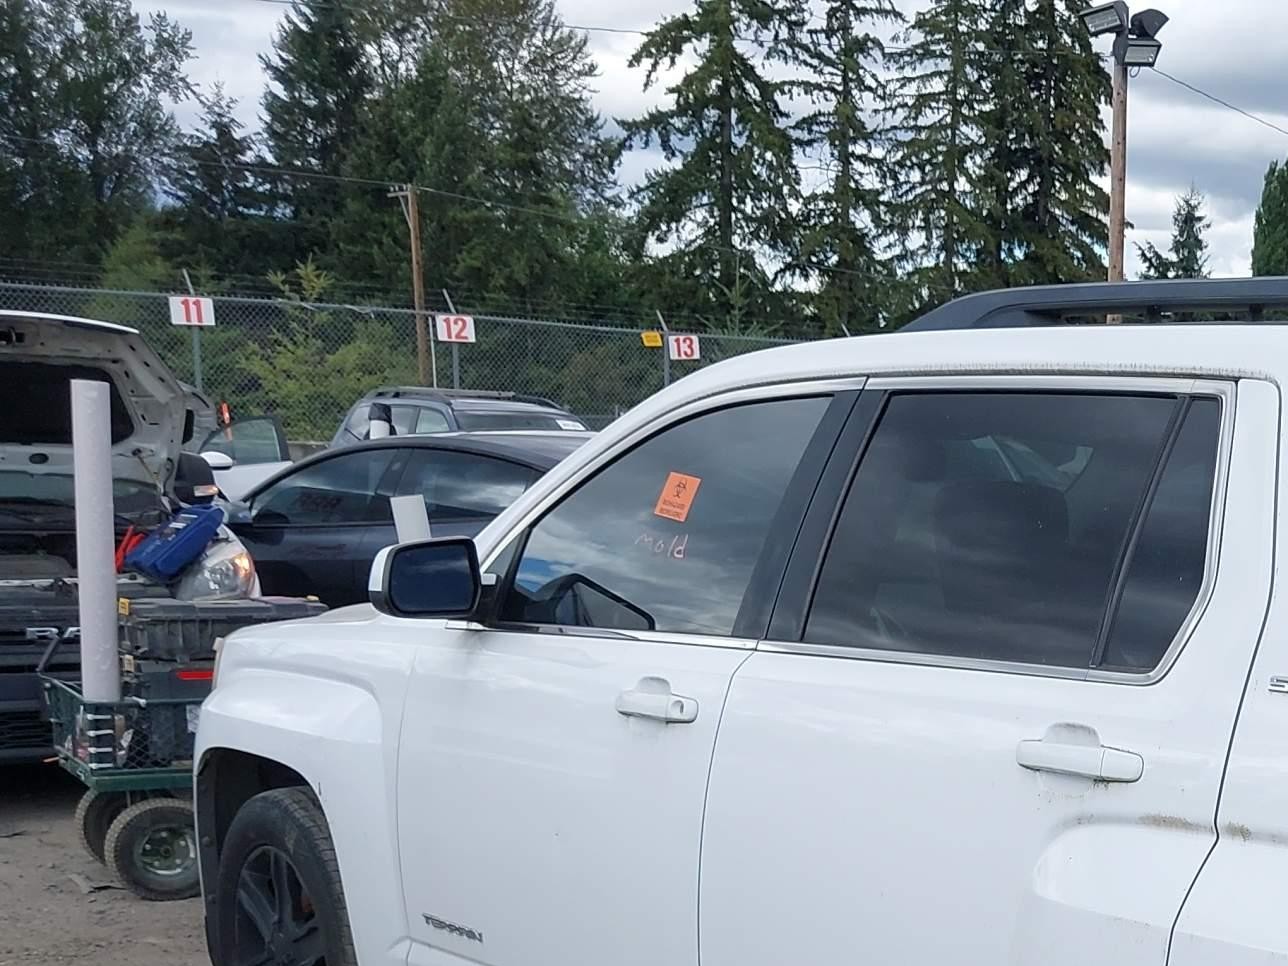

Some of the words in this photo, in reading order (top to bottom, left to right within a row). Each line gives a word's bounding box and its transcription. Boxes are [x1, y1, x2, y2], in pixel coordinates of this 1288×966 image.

[180, 298, 203, 323] 11
[442, 317, 469, 341] 12
[673, 336, 695, 359] 13
